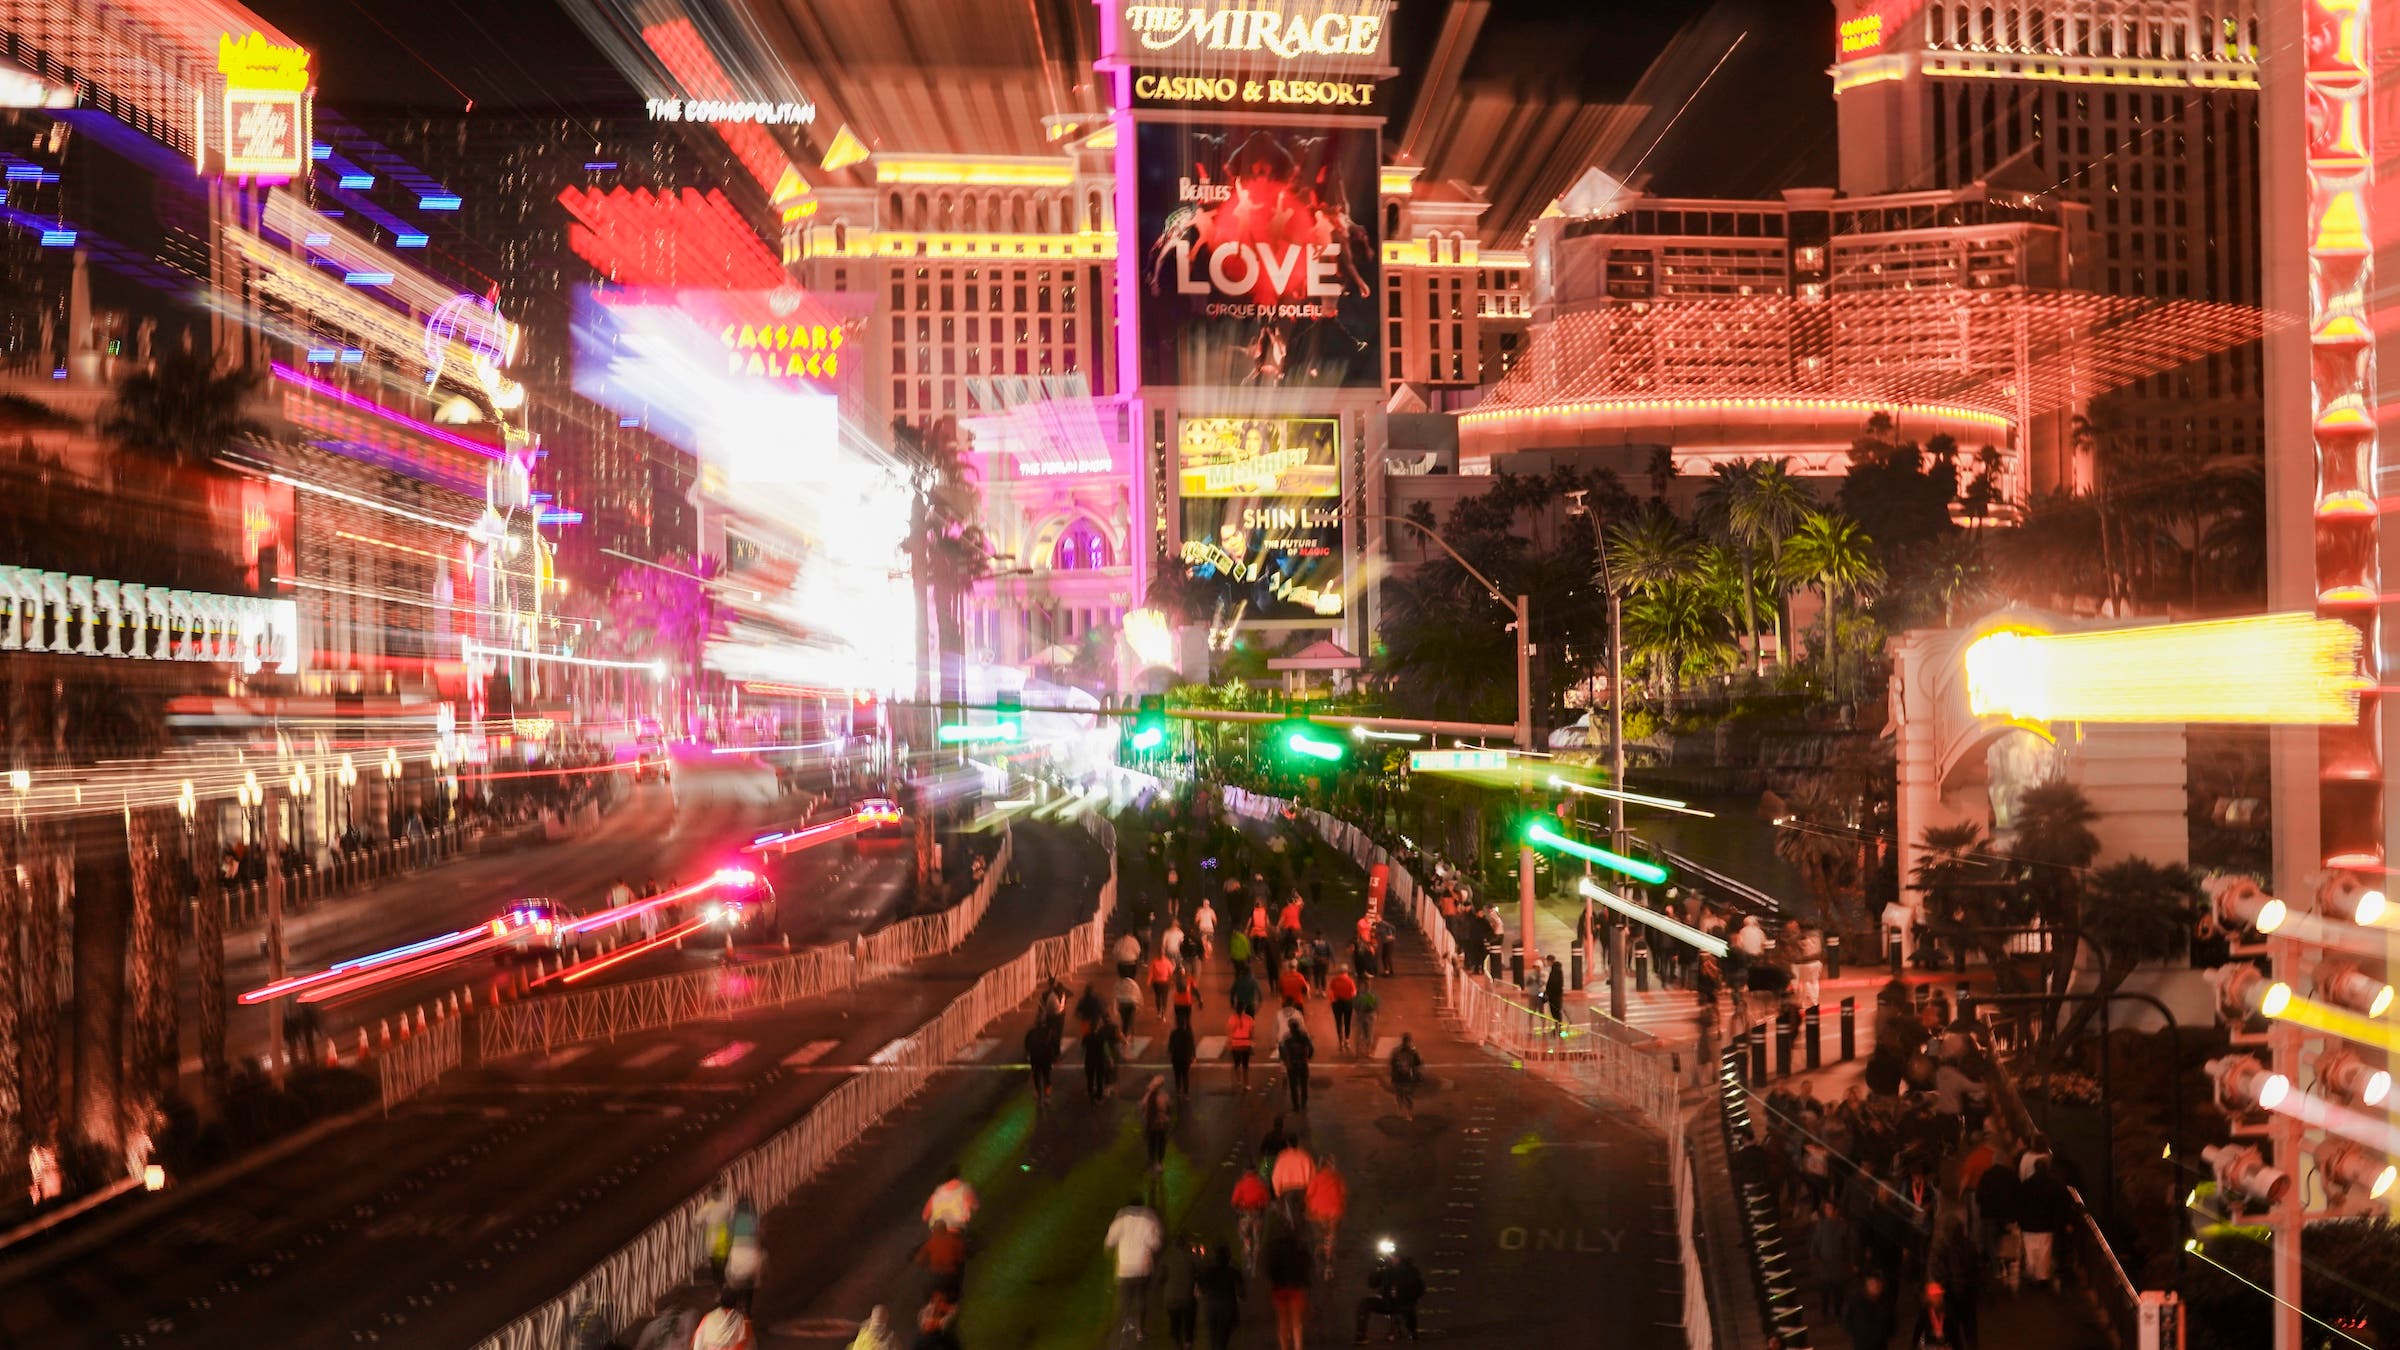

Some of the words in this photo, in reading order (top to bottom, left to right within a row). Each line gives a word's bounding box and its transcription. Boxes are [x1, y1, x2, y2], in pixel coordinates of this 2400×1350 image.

[1125, 6, 1184, 31] THE
[1141, 8, 1380, 59] MIRAGE
[1135, 75, 1238, 101] CASINO
[1242, 84, 1263, 102] &
[1268, 80, 1376, 105] RESORT
[646, 99, 682, 122] THE
[684, 101, 816, 125] COSMOPOLITAN
[1179, 177, 1232, 202] BEATLES
[1176, 240, 1343, 296] LOVE
[1206, 303, 1257, 318] CIRQUE
[1257, 305, 1277, 317] DU
[1278, 303, 1323, 317] SOLEIL
[720, 323, 844, 351] CAESARS
[727, 352, 838, 379] PALACE
[1243, 508, 1296, 530] SHIN
[1280, 539, 1318, 549] FUTURE
[1300, 548, 1330, 556] MAGIC
[1499, 1226, 1626, 1252] ONLY
